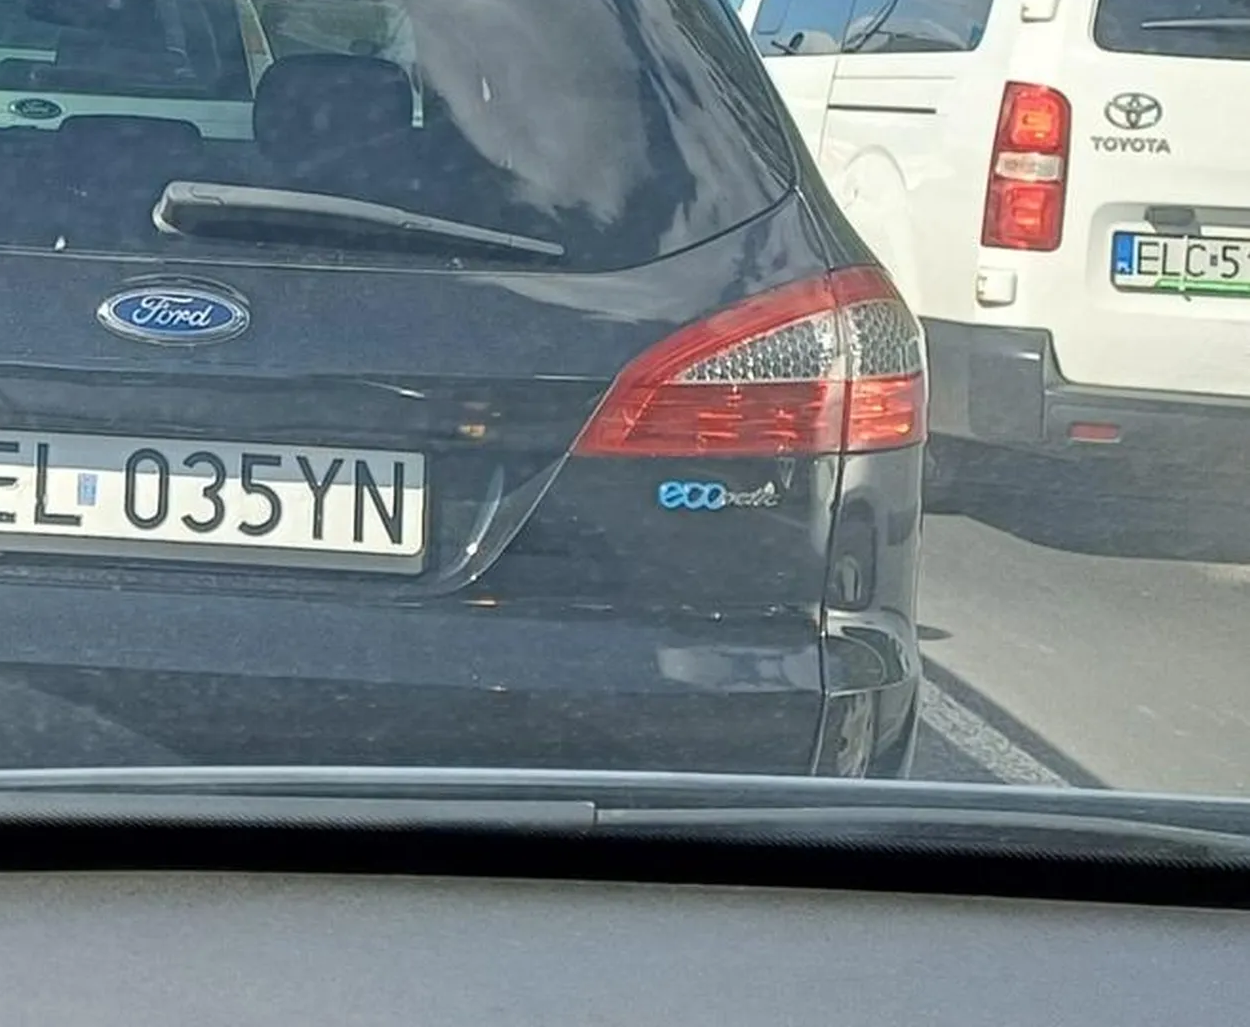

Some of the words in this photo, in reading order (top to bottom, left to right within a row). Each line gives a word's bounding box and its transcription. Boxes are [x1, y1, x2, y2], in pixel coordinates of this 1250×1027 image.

[1090, 137, 1171, 153] TOYOTA
[1138, 241, 1206, 277] ELC
[132, 295, 214, 326] Ford
[124, 448, 405, 546] 035YN
